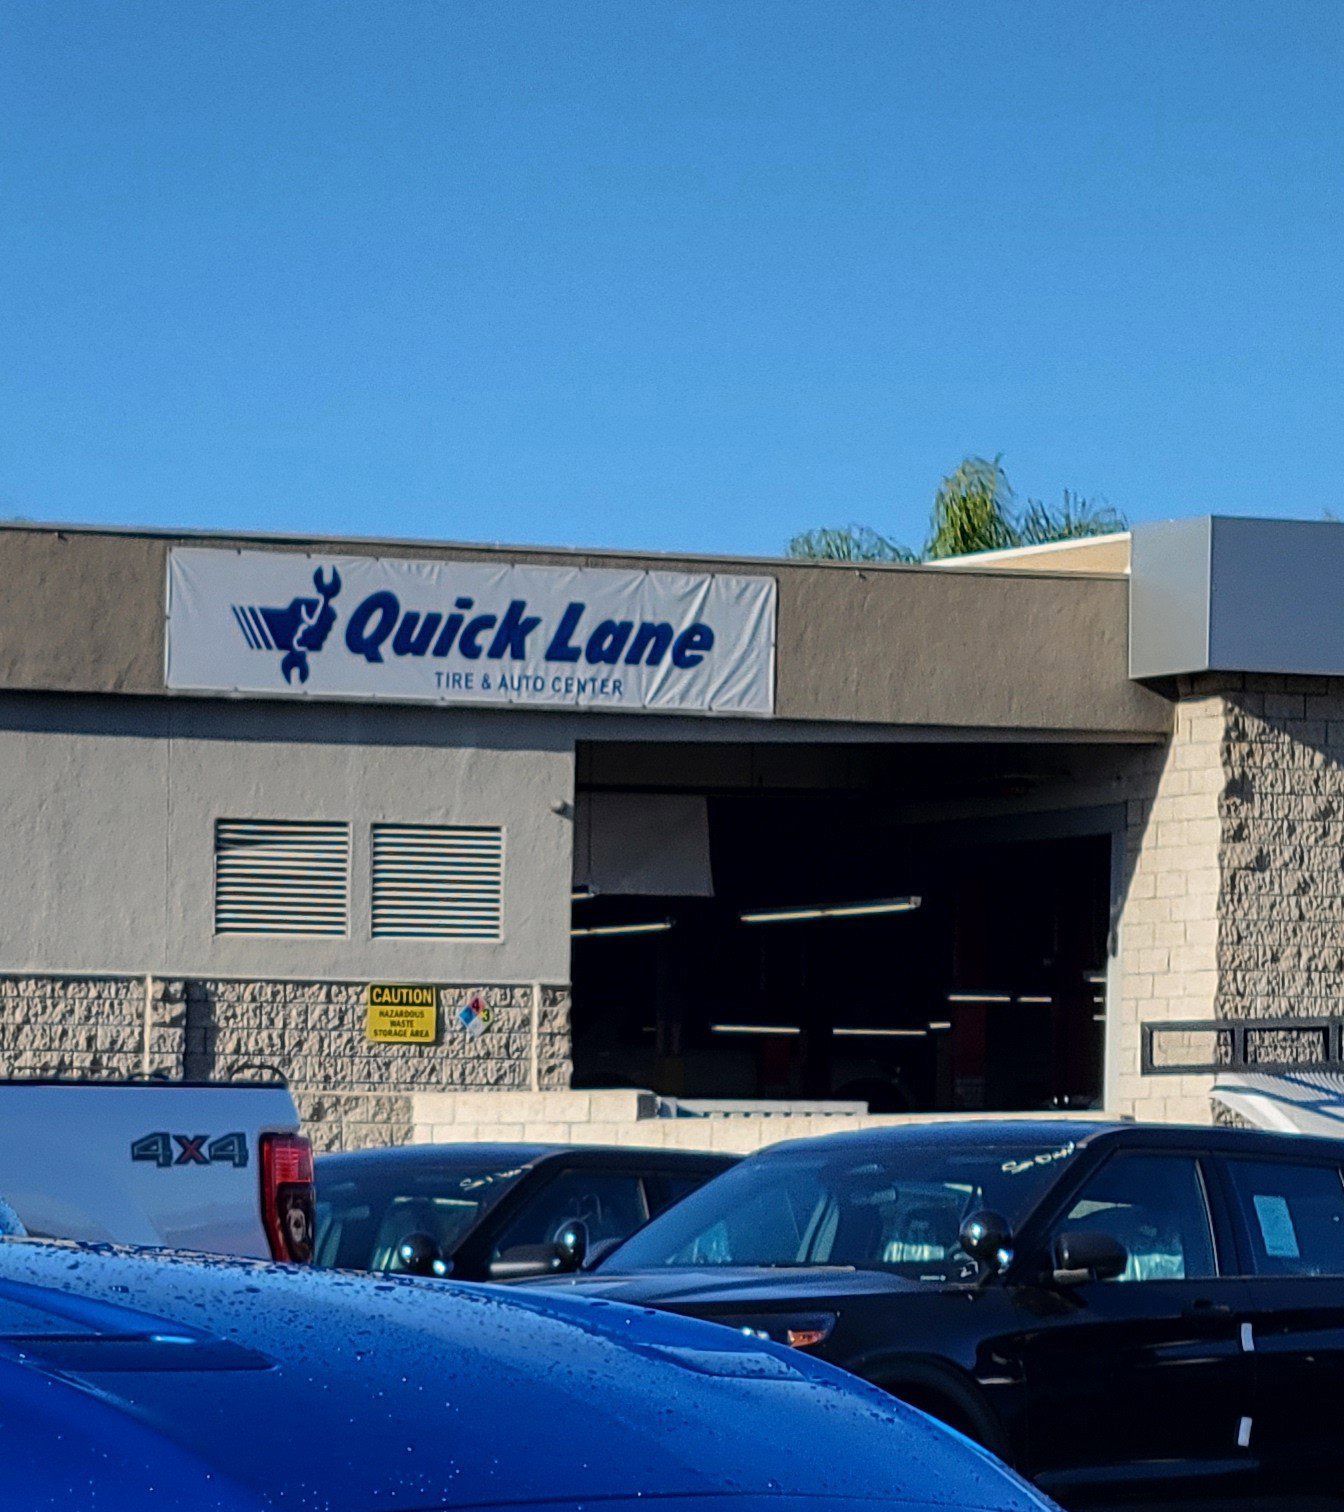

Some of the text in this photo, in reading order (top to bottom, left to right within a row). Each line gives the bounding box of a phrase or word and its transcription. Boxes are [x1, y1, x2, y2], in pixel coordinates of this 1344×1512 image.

[345, 591, 715, 670] Quick Lane
[434, 671, 624, 696] TIRE & AUTO CENTER
[372, 986, 433, 1004] CAUTION
[472, 997, 481, 1013] 4
[378, 1009, 424, 1019] HAZARDOUS
[481, 1008, 490, 1022] 3
[389, 1019, 414, 1028] WASTE
[373, 1028, 430, 1038] STORAGE AREA
